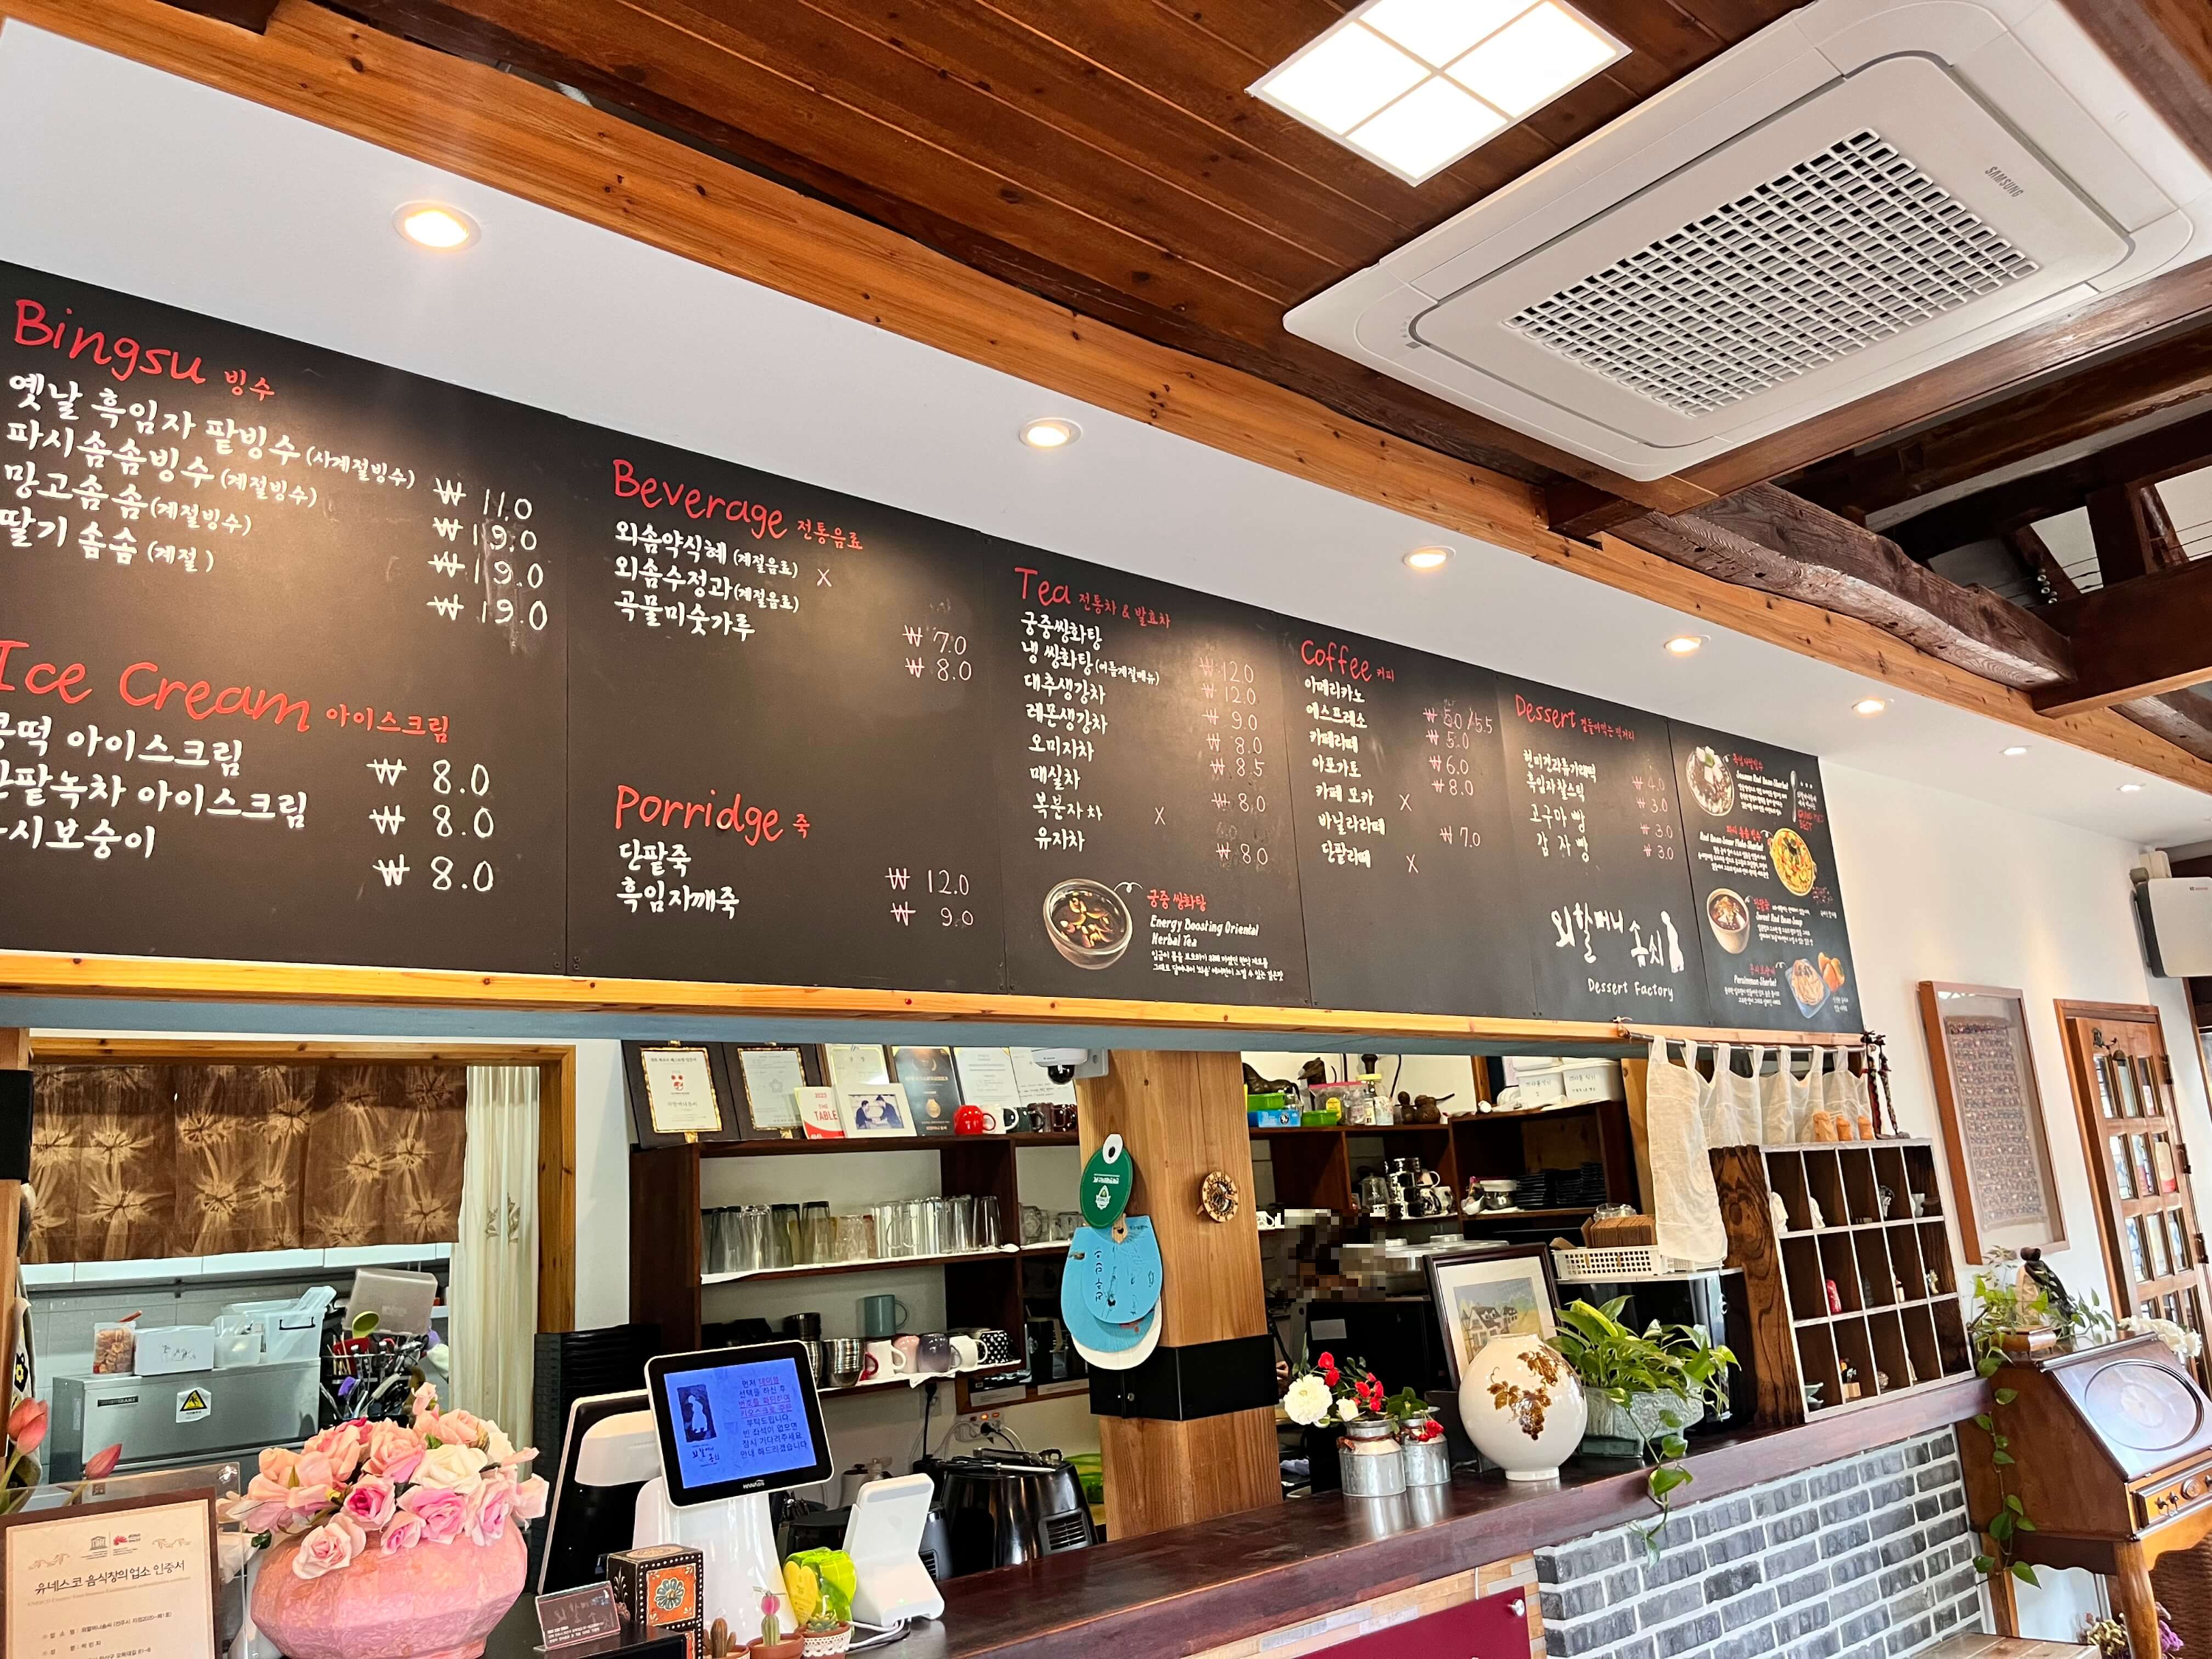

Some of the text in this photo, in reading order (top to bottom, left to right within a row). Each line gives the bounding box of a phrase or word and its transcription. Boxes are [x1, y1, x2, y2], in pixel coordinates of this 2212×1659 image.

[1985, 167, 2023, 197] SAMSUNG
[13, 298, 275, 401] Bingsu 빙수
[9, 372, 83, 420] 옛날
[91, 386, 197, 441] 흑임자
[205, 417, 301, 466] 팥빙수
[220, 468, 318, 507] (계절빙수)
[150, 495, 252, 538] (계절빙수)
[612, 459, 863, 550] Beverage 전통음료
[0, 507, 68, 549] 딸기
[1014, 566, 1071, 606] Tea
[1079, 592, 1117, 616] 전통차
[1134, 607, 1171, 628] 발효차
[613, 590, 756, 642] 곡물미숫가루
[1020, 611, 1103, 650] 궁중쌍화탕
[932, 630, 967, 655] 7.0
[1021, 640, 1039, 664] 냉
[936, 658, 973, 681] 8.0
[1301, 639, 1394, 683] Coffee 커피
[0, 639, 450, 743] Ice Cream 아이스크림
[1023, 672, 1106, 705] 대추생강차
[1304, 675, 1365, 703] 아메리카노
[1026, 702, 1108, 735] 레몬생강차
[1231, 712, 1258, 731] 9.0
[1306, 701, 1367, 728] 에스프레소
[1515, 693, 1578, 729] Dessert
[66, 724, 243, 776] 아이스크림
[1028, 733, 1094, 762] 오미자차
[1234, 737, 1262, 755] 8.0
[432, 758, 490, 796] 8.0
[1029, 764, 1081, 790] 매실차
[1312, 754, 1361, 778] 아포가토
[1446, 755, 1469, 775] 6.0
[1449, 779, 1473, 796] 8.0
[137, 782, 308, 830] 아이스크림
[432, 804, 495, 839] 8.0
[615, 784, 810, 846] Porridge 죽
[0, 815, 156, 859] 시보숭이
[1034, 826, 1085, 852] 유자차
[1459, 827, 1481, 848] 7.0
[619, 838, 692, 877] 단팥죽
[430, 856, 494, 893] 8.0
[928, 869, 970, 896] 12.0
[616, 875, 740, 919] 흑임자깨죽
[940, 906, 974, 927] 9.0
[1150, 914, 1259, 936] Energy Boosting Oriental
[1152, 931, 1197, 947] Herbal Tea
[1587, 978, 1673, 1002] Dessert Factory
[814, 1110, 838, 1121] TABLE
[35, 1576, 83, 1595] 유네스코
[153, 1559, 184, 1575] 인증서
